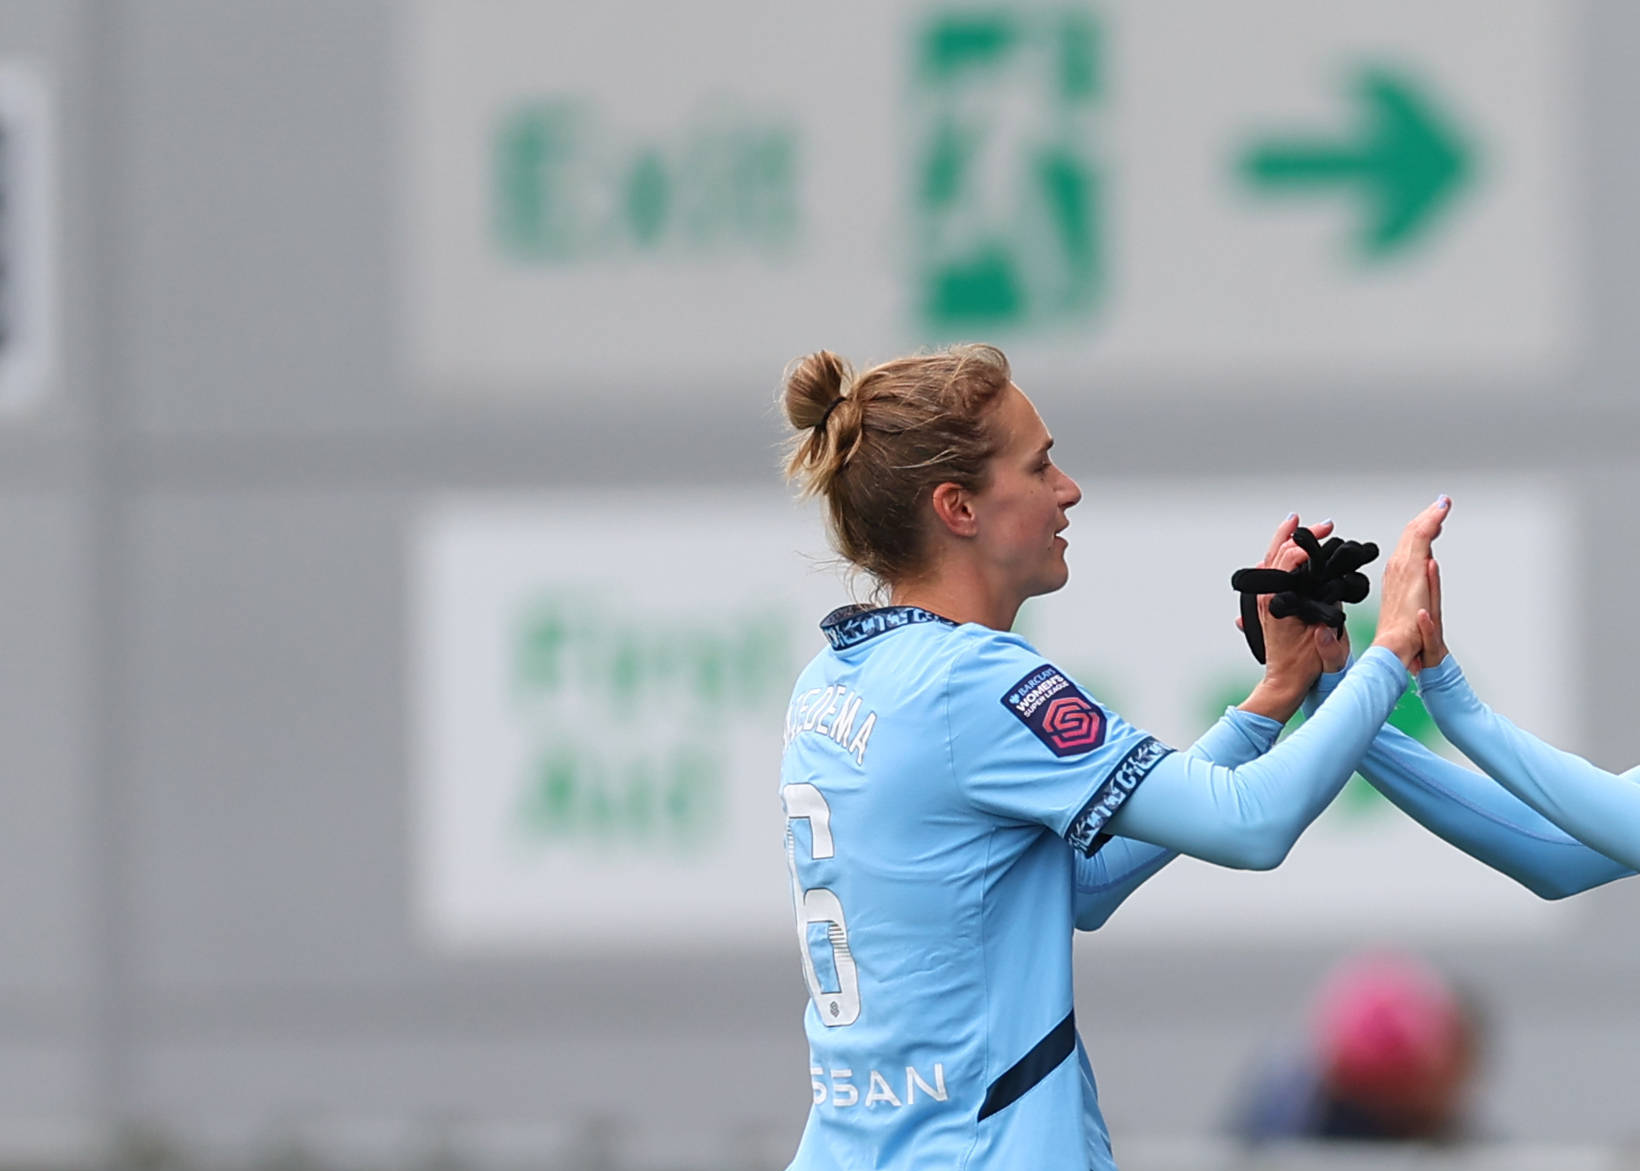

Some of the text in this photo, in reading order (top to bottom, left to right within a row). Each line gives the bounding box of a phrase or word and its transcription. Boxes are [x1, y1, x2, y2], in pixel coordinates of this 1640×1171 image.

[1015, 674, 1065, 712] WOMEN'S
[1017, 667, 1057, 697] BARCLAYS
[1023, 680, 1070, 718] SUPER LEAGUE
[783, 782, 861, 1026] 6
